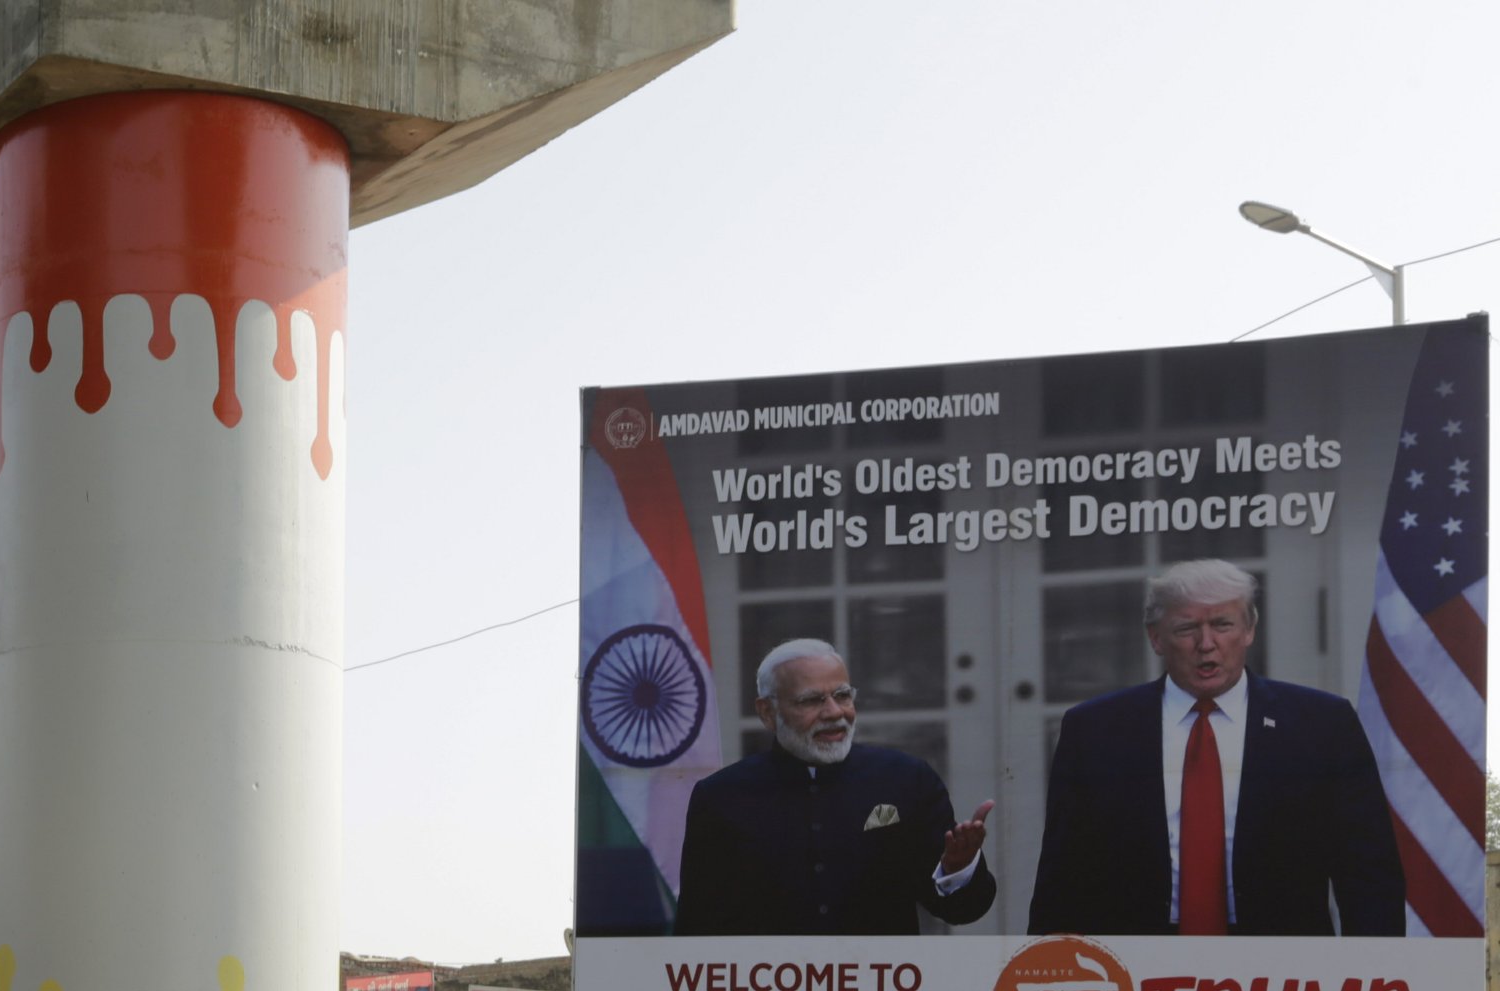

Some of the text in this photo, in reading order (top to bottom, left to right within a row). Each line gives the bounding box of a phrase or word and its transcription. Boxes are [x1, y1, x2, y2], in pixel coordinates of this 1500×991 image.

[658, 392, 1000, 437] AMDAVAD MUNICIPAL CORPORATION
[712, 434, 1342, 503] World's Oldest Democracy Meets
[712, 490, 1336, 555] World's Largest Democracy
[1014, 968, 1075, 977] NAMASTE
